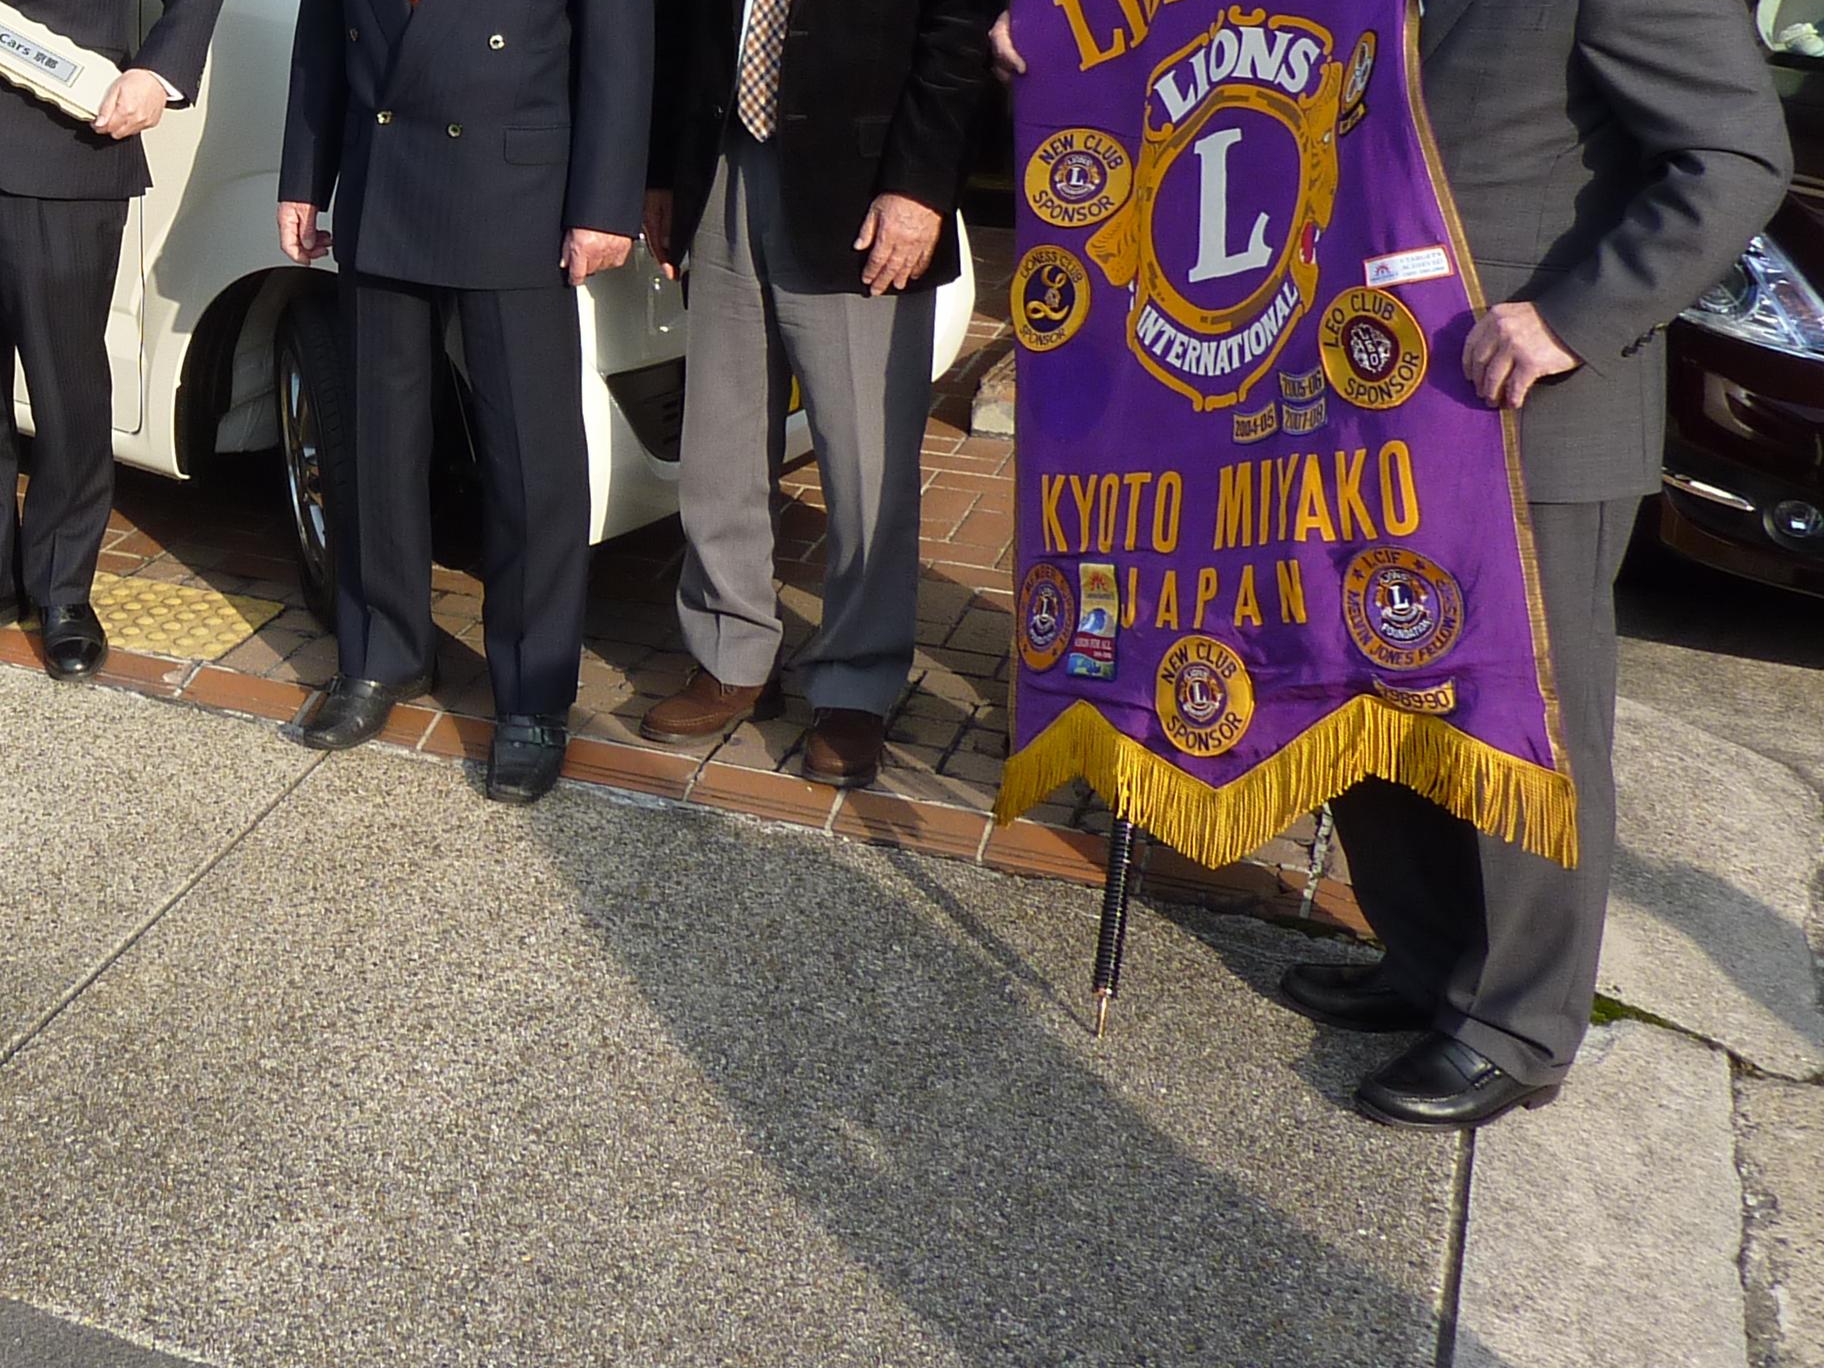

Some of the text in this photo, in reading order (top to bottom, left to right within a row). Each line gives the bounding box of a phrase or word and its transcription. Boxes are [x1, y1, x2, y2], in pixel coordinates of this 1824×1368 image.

[33, 50, 59, 70] 京都
[1153, 26, 1320, 123] LIONS
[1038, 134, 1124, 170] NEW CLUB
[1033, 190, 1115, 222] SPONSOR
[1188, 128, 1272, 282] L
[1059, 255, 1084, 283] CLUB
[1019, 324, 1066, 345] SPONSOR
[1136, 282, 1299, 376] INTERNATIONAL
[1323, 292, 1396, 349] LEO CLUB
[1344, 351, 1420, 405] SPONSOR
[1041, 440, 1419, 554] KYOTO MIYAKO
[1362, 549, 1401, 569] LCIF
[1121, 559, 1308, 630] JAPAN
[1161, 642, 1237, 685] NEW CLUB
[1370, 645, 1415, 666] JONES
[1167, 713, 1243, 751] SPONSOR
